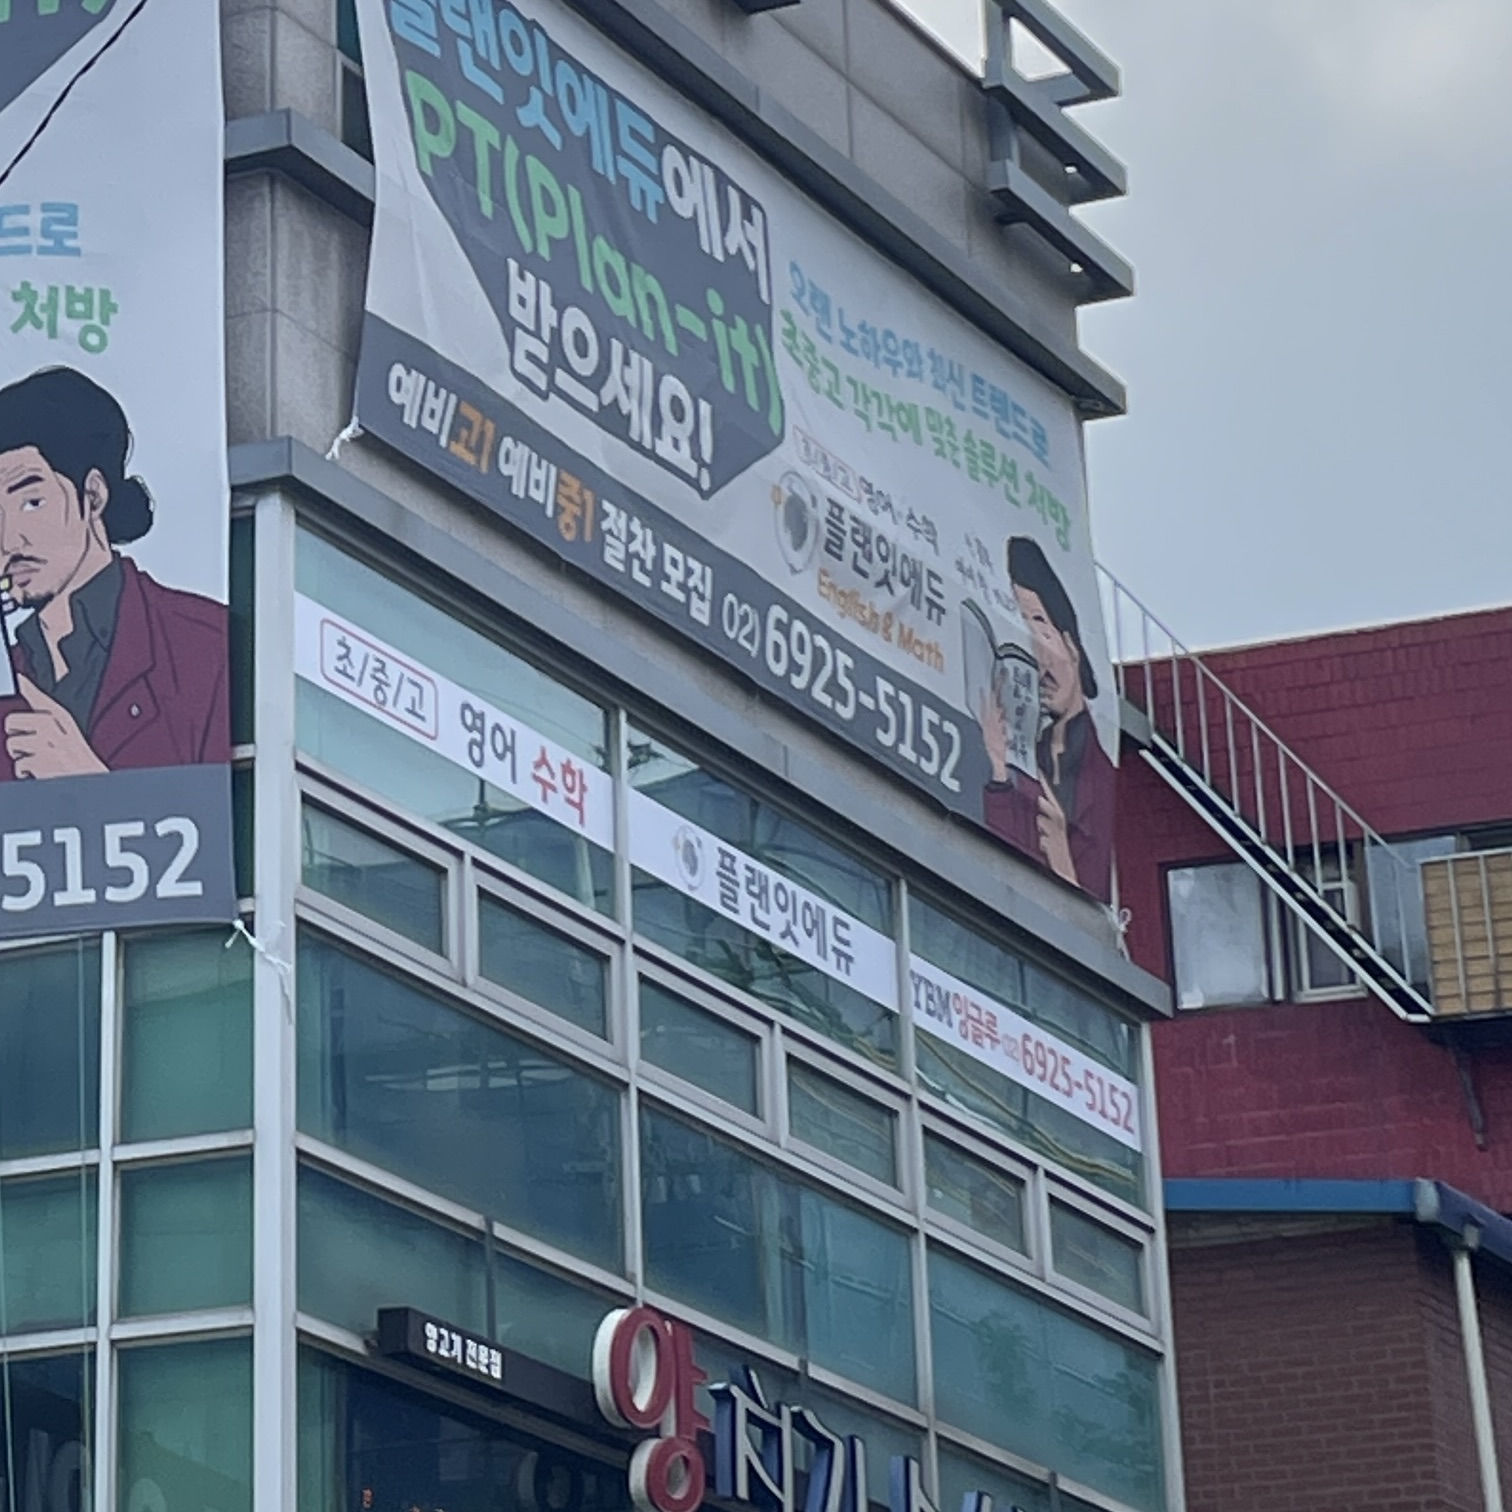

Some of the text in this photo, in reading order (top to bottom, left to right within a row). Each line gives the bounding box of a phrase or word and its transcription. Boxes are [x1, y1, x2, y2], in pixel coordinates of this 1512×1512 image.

[10, 282, 118, 353] 처방
[404, 70, 782, 435] PT(Plan-it)
[507, 257, 713, 489] 받으세요!
[388, 362, 713, 626] 예비고1 예비중1 절찬 모집
[824, 497, 946, 626] 플랜잇에듀
[459, 701, 517, 784] 영어
[531, 746, 587, 827] 수학
[765, 605, 962, 792] 6925-5152
[715, 845, 855, 977] 플랜잇에듀
